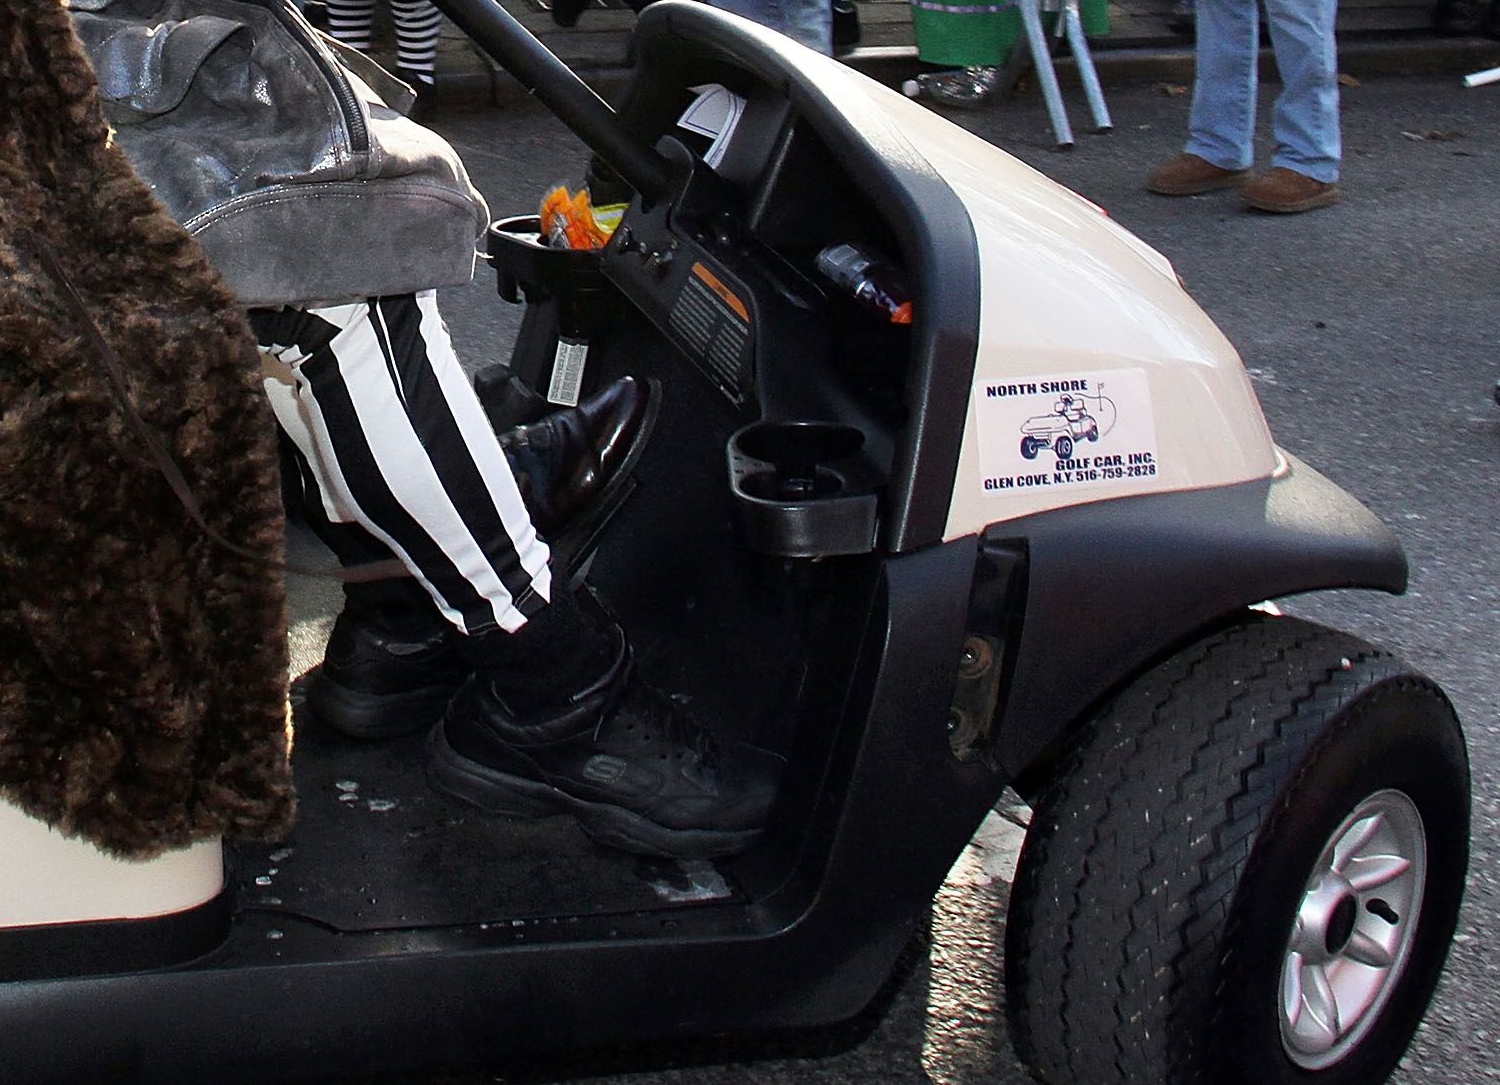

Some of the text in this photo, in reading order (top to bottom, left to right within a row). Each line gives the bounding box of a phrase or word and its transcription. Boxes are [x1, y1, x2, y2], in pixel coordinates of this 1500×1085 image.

[986, 379, 1088, 397] NORTH SHORE
[1055, 456, 1091, 471] GOLF
[1128, 452, 1156, 465] INC.
[984, 475, 1014, 490] GLEN
[1053, 470, 1074, 484] N.Y.
[1075, 464, 1156, 482] 516-759-2828
